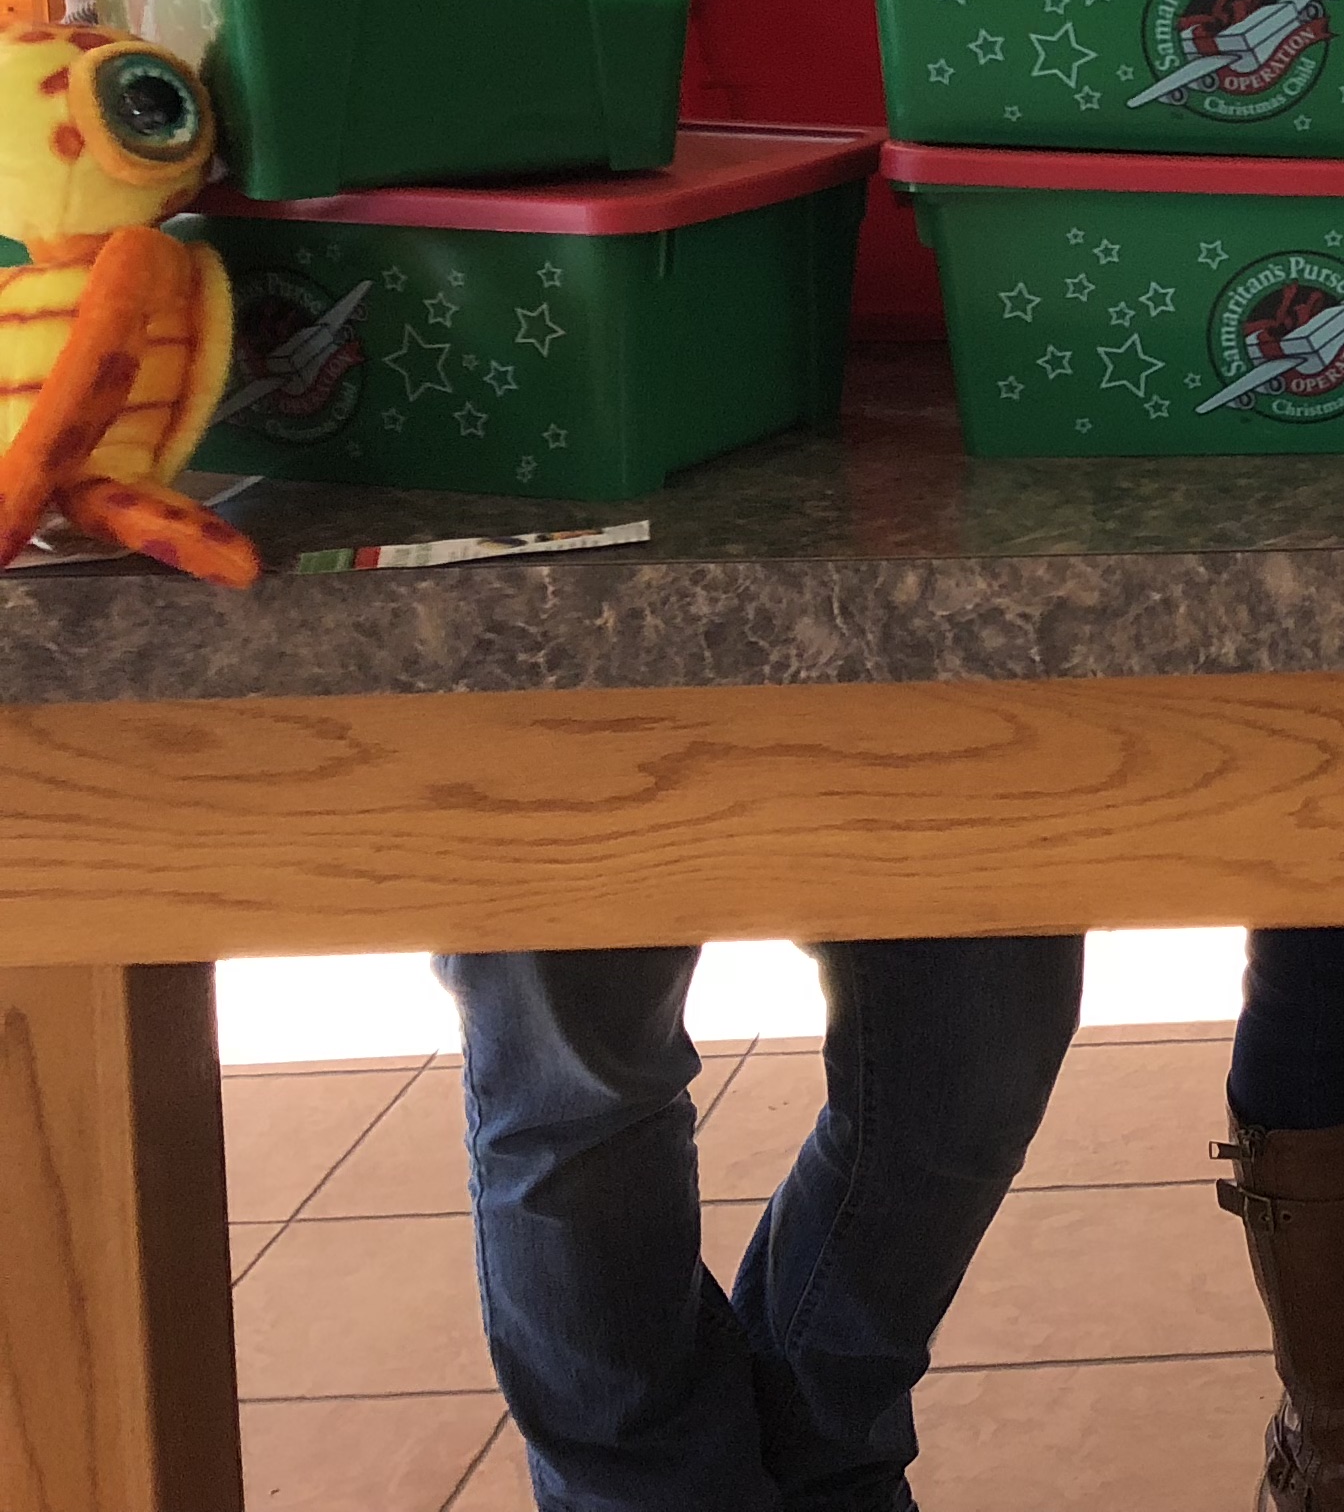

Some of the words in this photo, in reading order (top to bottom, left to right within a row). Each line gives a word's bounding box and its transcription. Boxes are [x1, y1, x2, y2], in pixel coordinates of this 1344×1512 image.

[1203, 94, 1287, 117] Christmas
[1282, 57, 1316, 97] Child
[1223, 27, 1316, 91] OPERATION
[1219, 263, 1287, 377] Samaritan's
